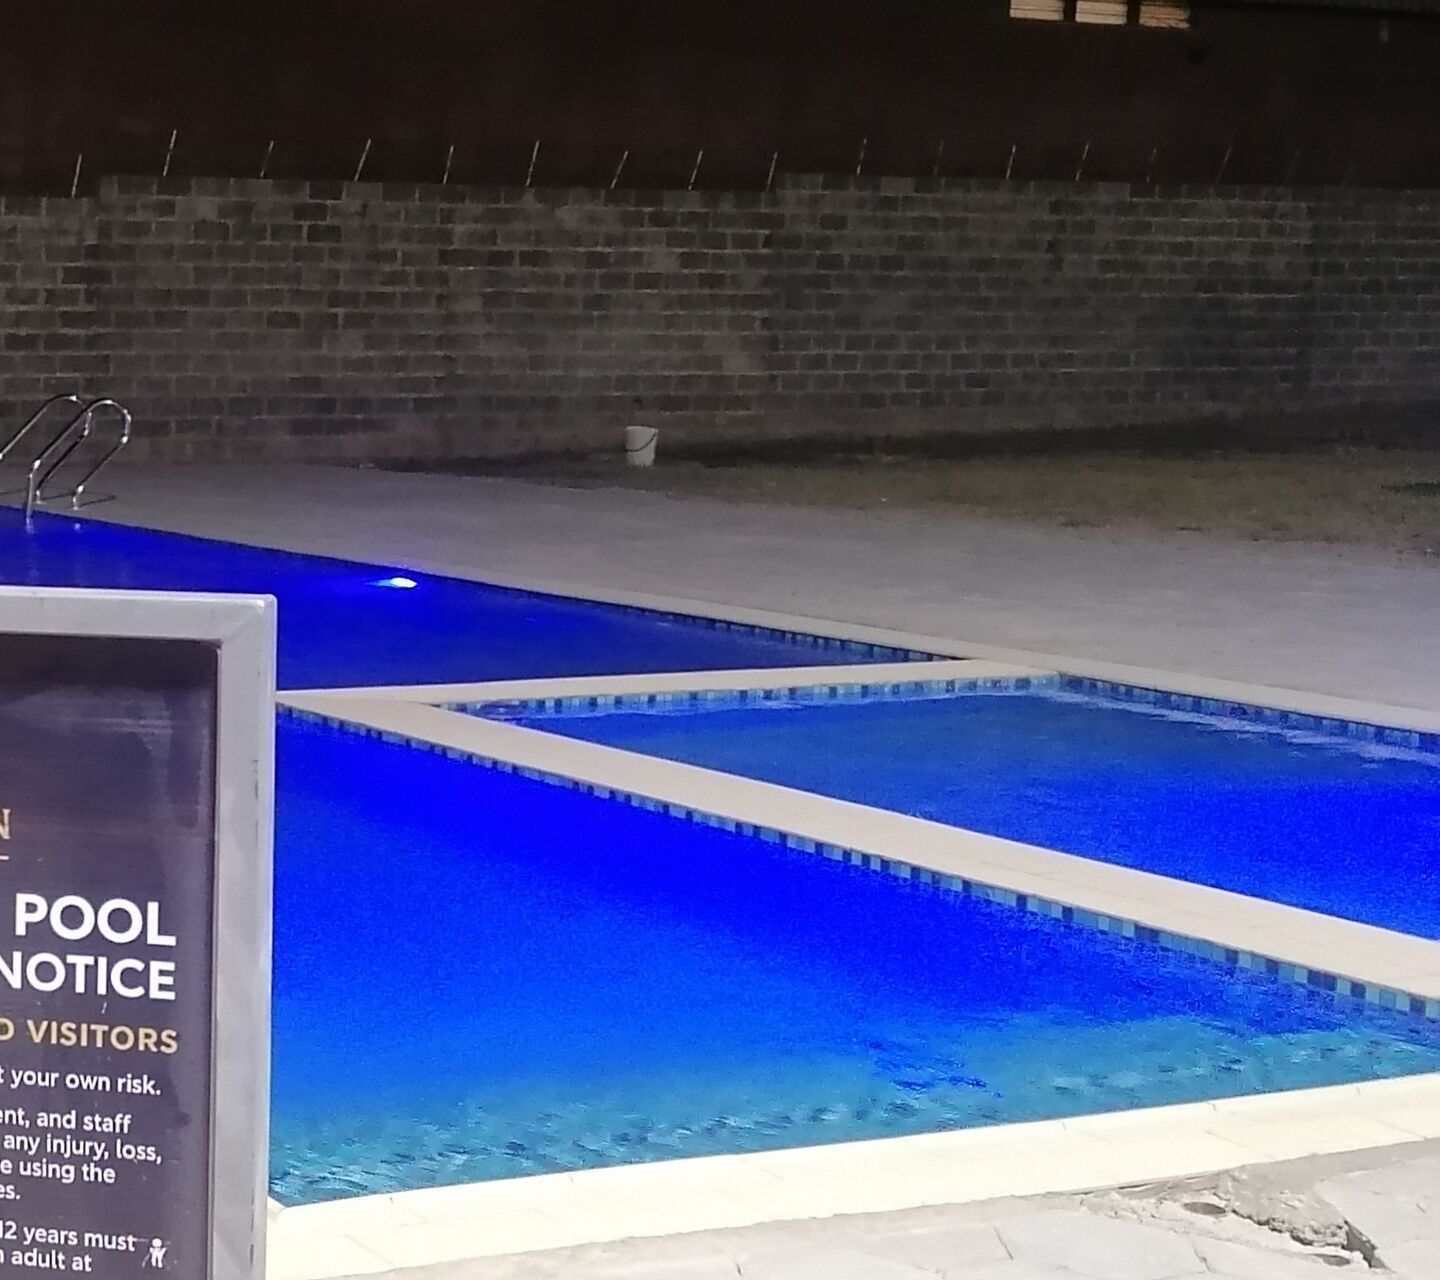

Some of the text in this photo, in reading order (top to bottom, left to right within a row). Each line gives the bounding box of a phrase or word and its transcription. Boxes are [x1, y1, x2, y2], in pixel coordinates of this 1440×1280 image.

[14, 892, 177, 947] POOL
[26, 1019, 178, 1055] VISITORS
[9, 1068, 61, 1090] your
[64, 1072, 111, 1093] own
[116, 1072, 162, 1096] risk.
[36, 1109, 77, 1130] and
[82, 1112, 133, 1135] staff
[3, 1134, 41, 1157] any
[46, 1132, 110, 1161] injury,
[115, 1137, 162, 1165] loss,
[18, 1157, 76, 1184] using
[80, 1158, 116, 1185] the
[22, 1226, 79, 1246] years
[83, 1231, 138, 1252] must
[10, 1247, 66, 1271] adult
[71, 1253, 93, 1273] at
